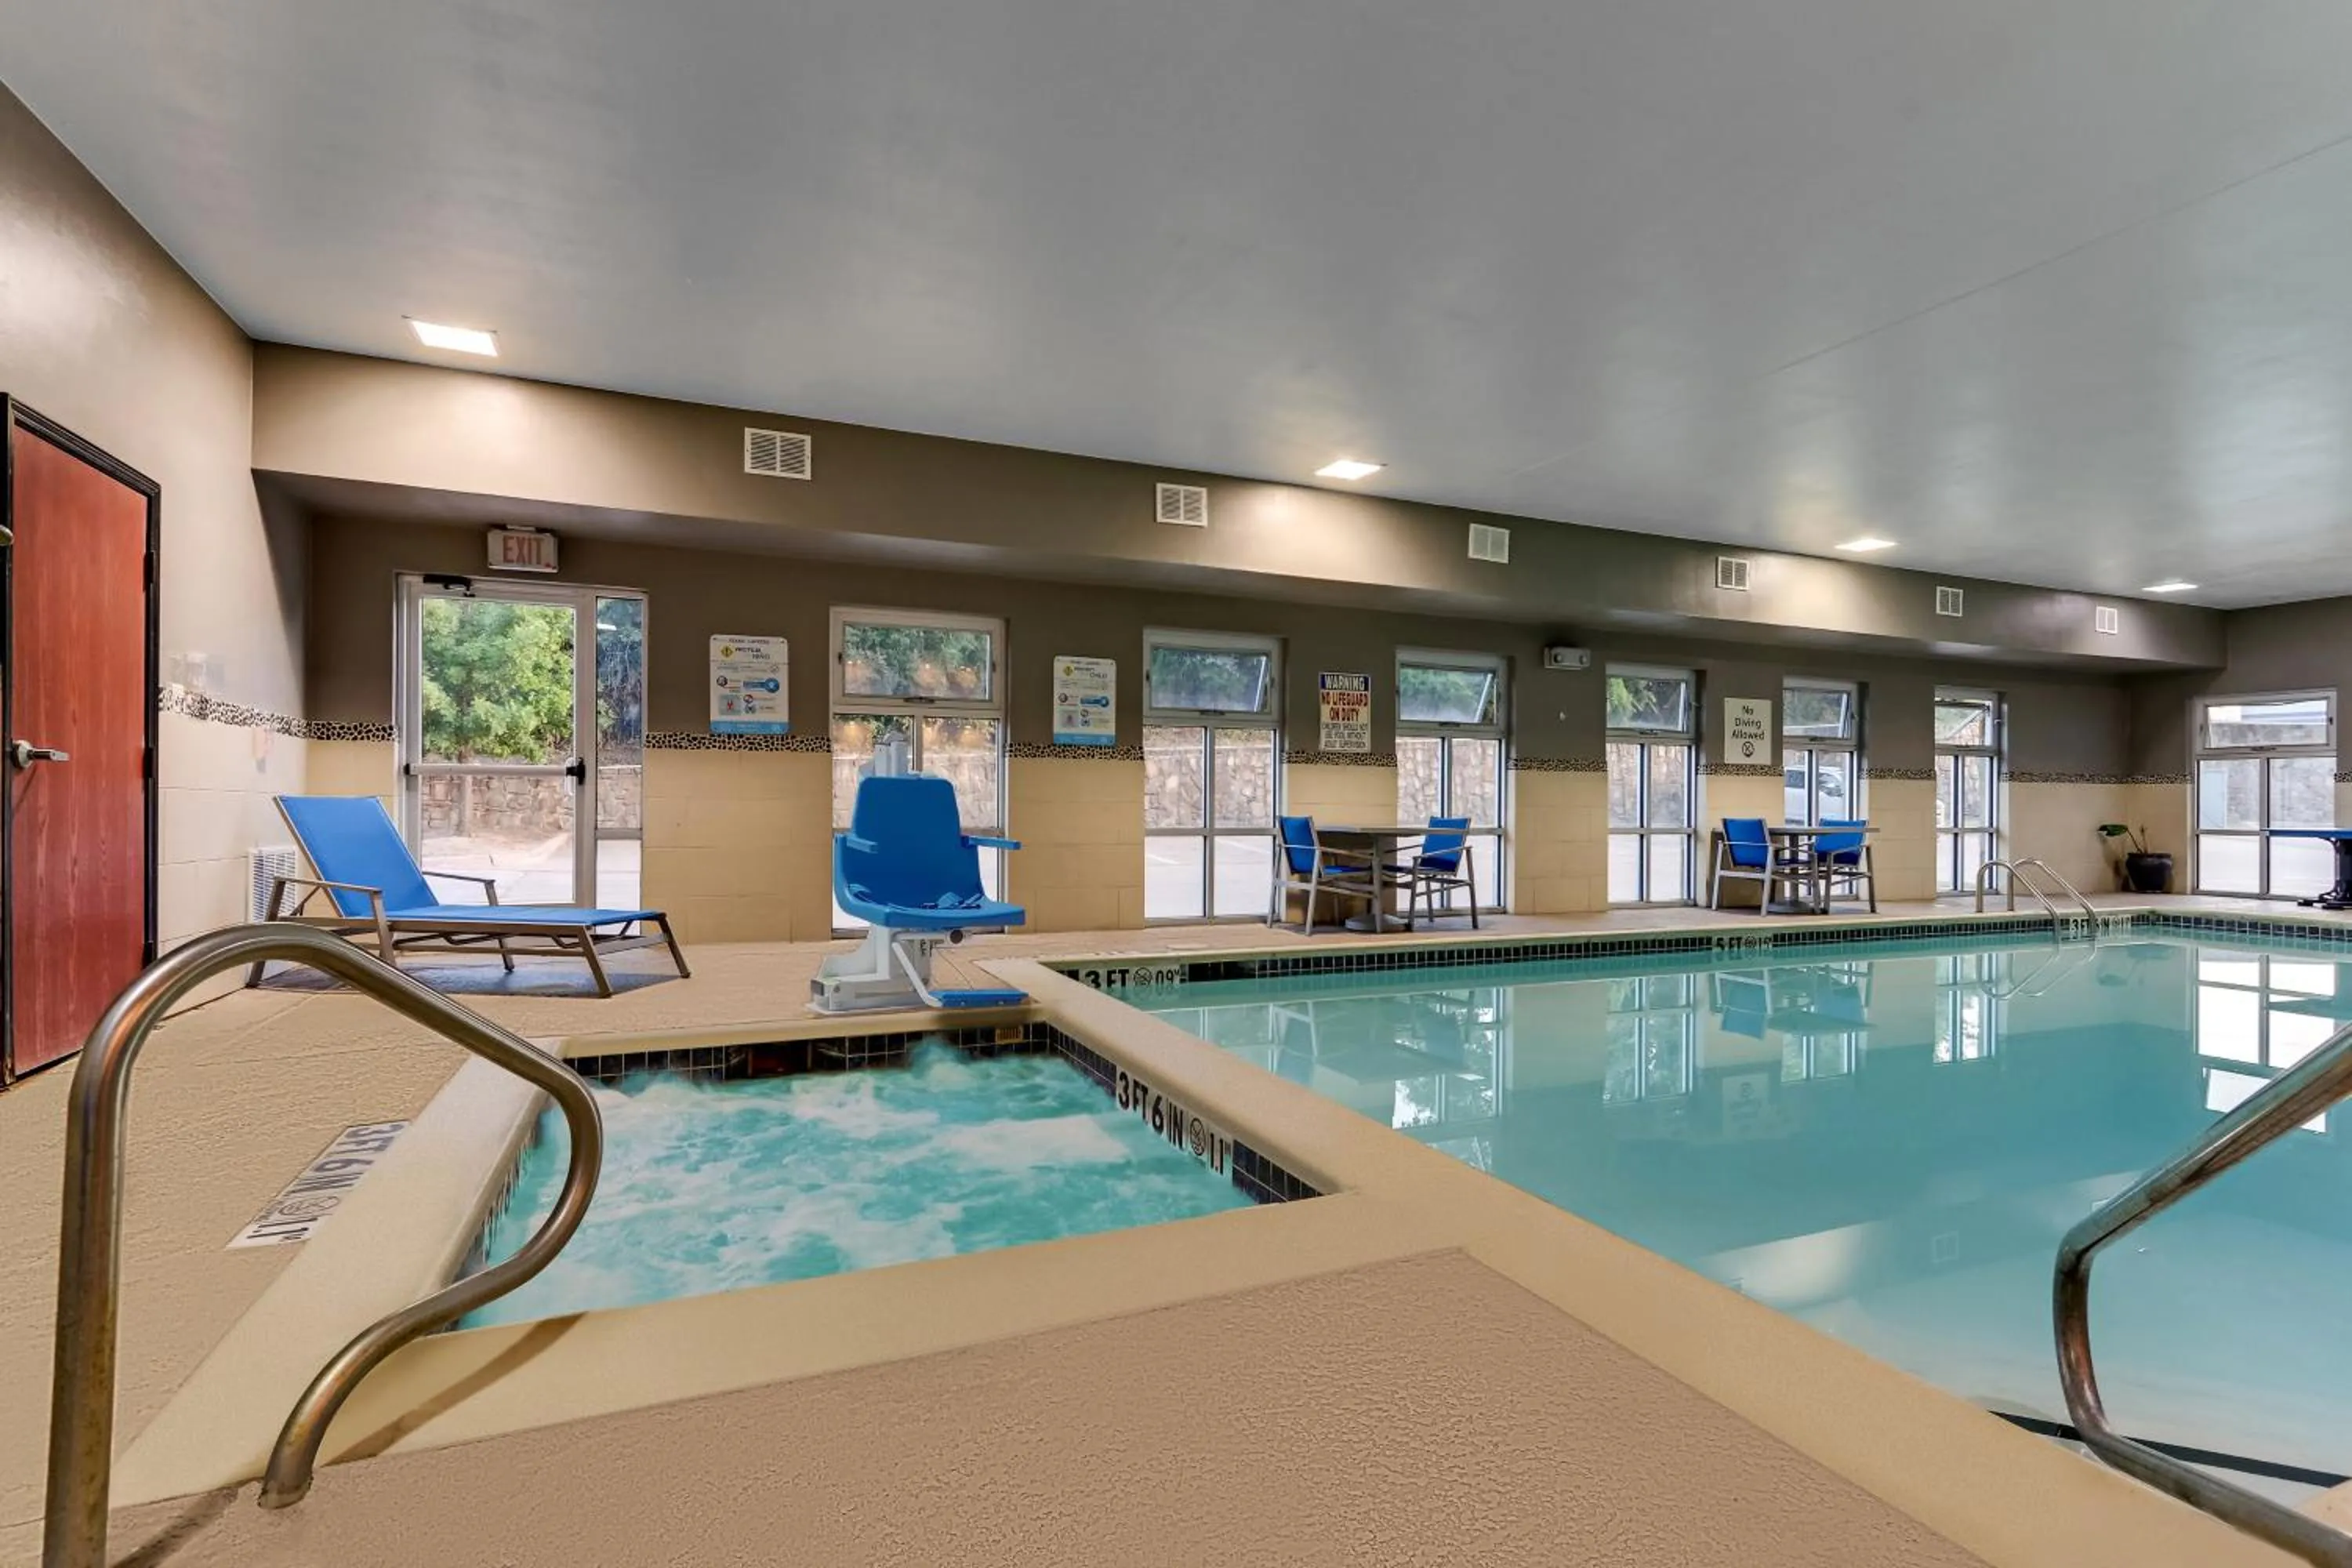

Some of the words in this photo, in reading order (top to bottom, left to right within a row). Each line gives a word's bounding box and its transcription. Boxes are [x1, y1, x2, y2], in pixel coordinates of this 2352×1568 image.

[503, 535, 545, 565] EXIT
[1326, 675, 1365, 691] WARNING
[1321, 691, 1330, 705] NO
[1332, 691, 1368, 706] LIFEGUARD
[1329, 706, 1340, 720] ON
[1341, 707, 1359, 721] DUTY
[1742, 706, 1754, 715] No
[1734, 717, 1762, 729] Diving
[1731, 729, 1765, 740] Allowed
[1729, 937, 1742, 950] FT
[1084, 970, 1102, 989] 3
[1106, 969, 1130, 988] FT
[1118, 1071, 1130, 1111] 3
[1133, 1078, 1149, 1120] FT
[1152, 1094, 1164, 1135] 6
[1168, 1101, 1184, 1151] IN
[312, 1158, 376, 1173] 6
